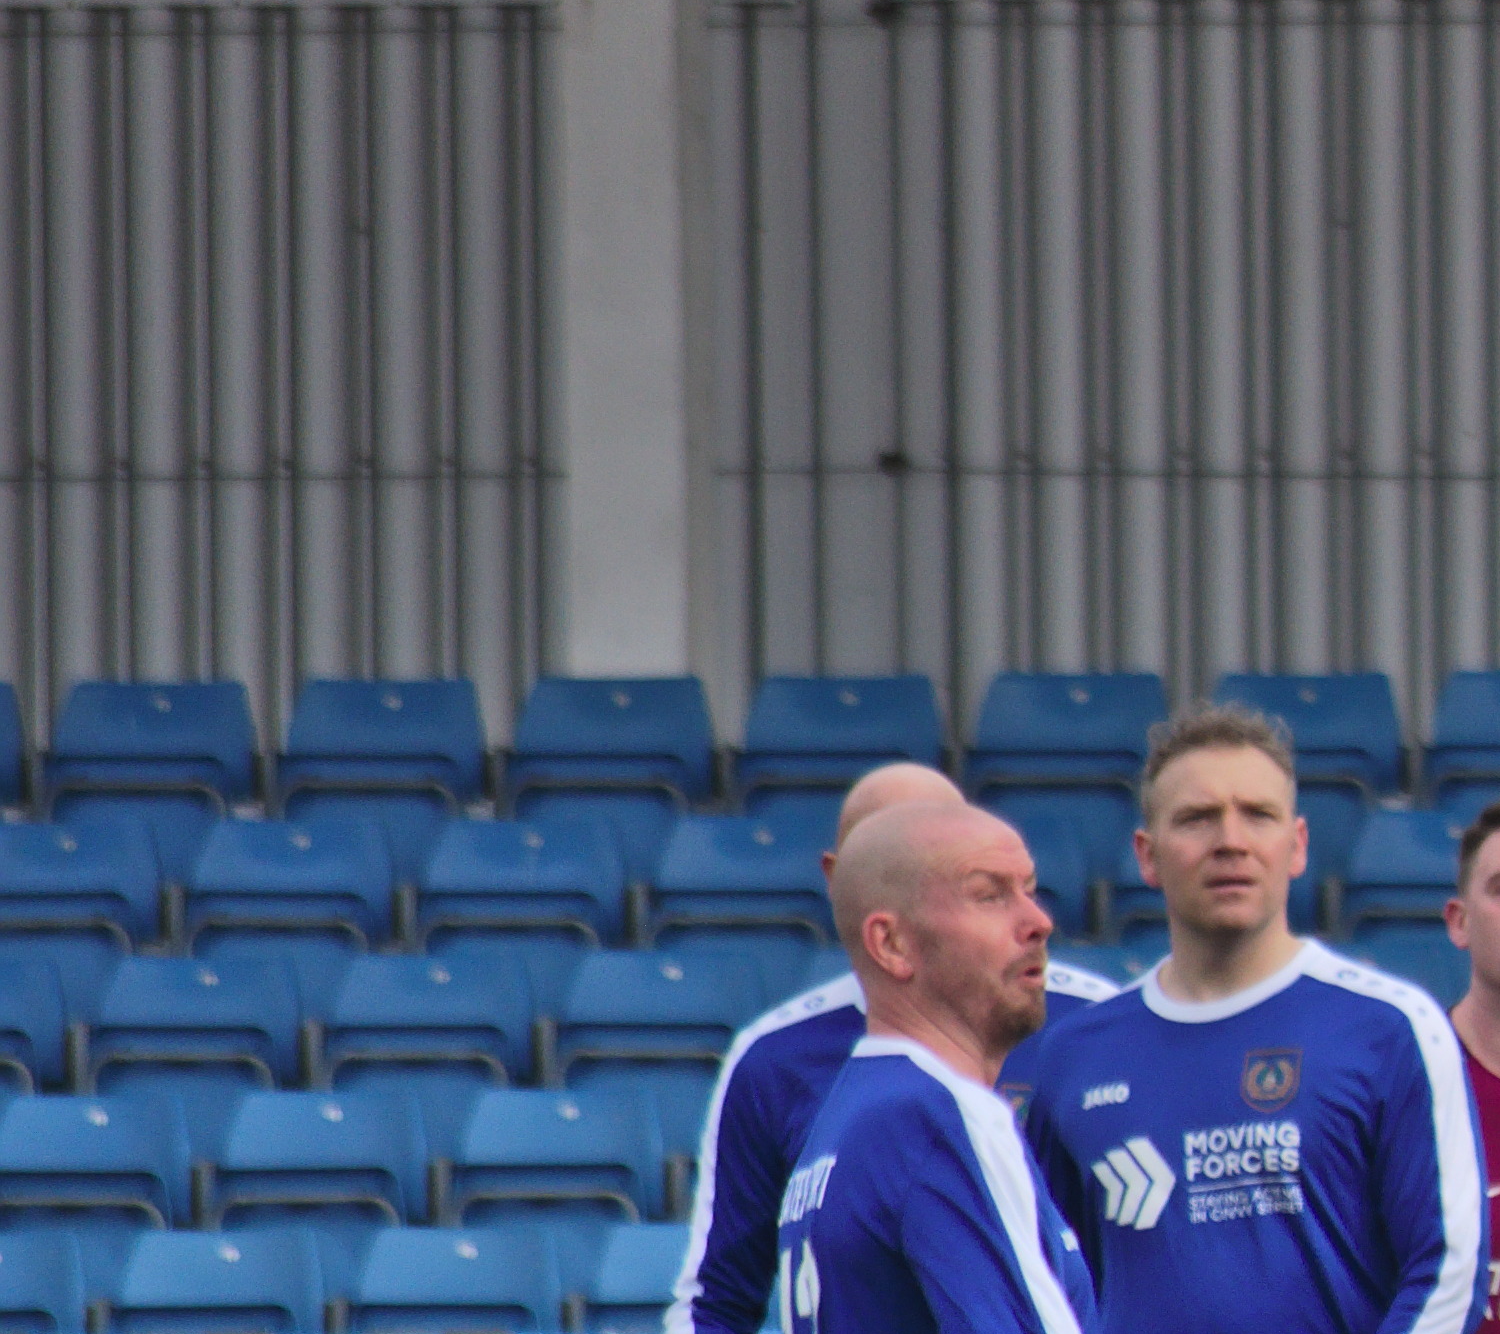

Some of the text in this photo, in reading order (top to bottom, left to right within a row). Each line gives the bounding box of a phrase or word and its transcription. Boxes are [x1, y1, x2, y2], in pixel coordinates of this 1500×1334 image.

[1082, 1082, 1130, 1111] JAKO
[1184, 1121, 1301, 1155] MOVING
[1185, 1147, 1300, 1183] FORCES
